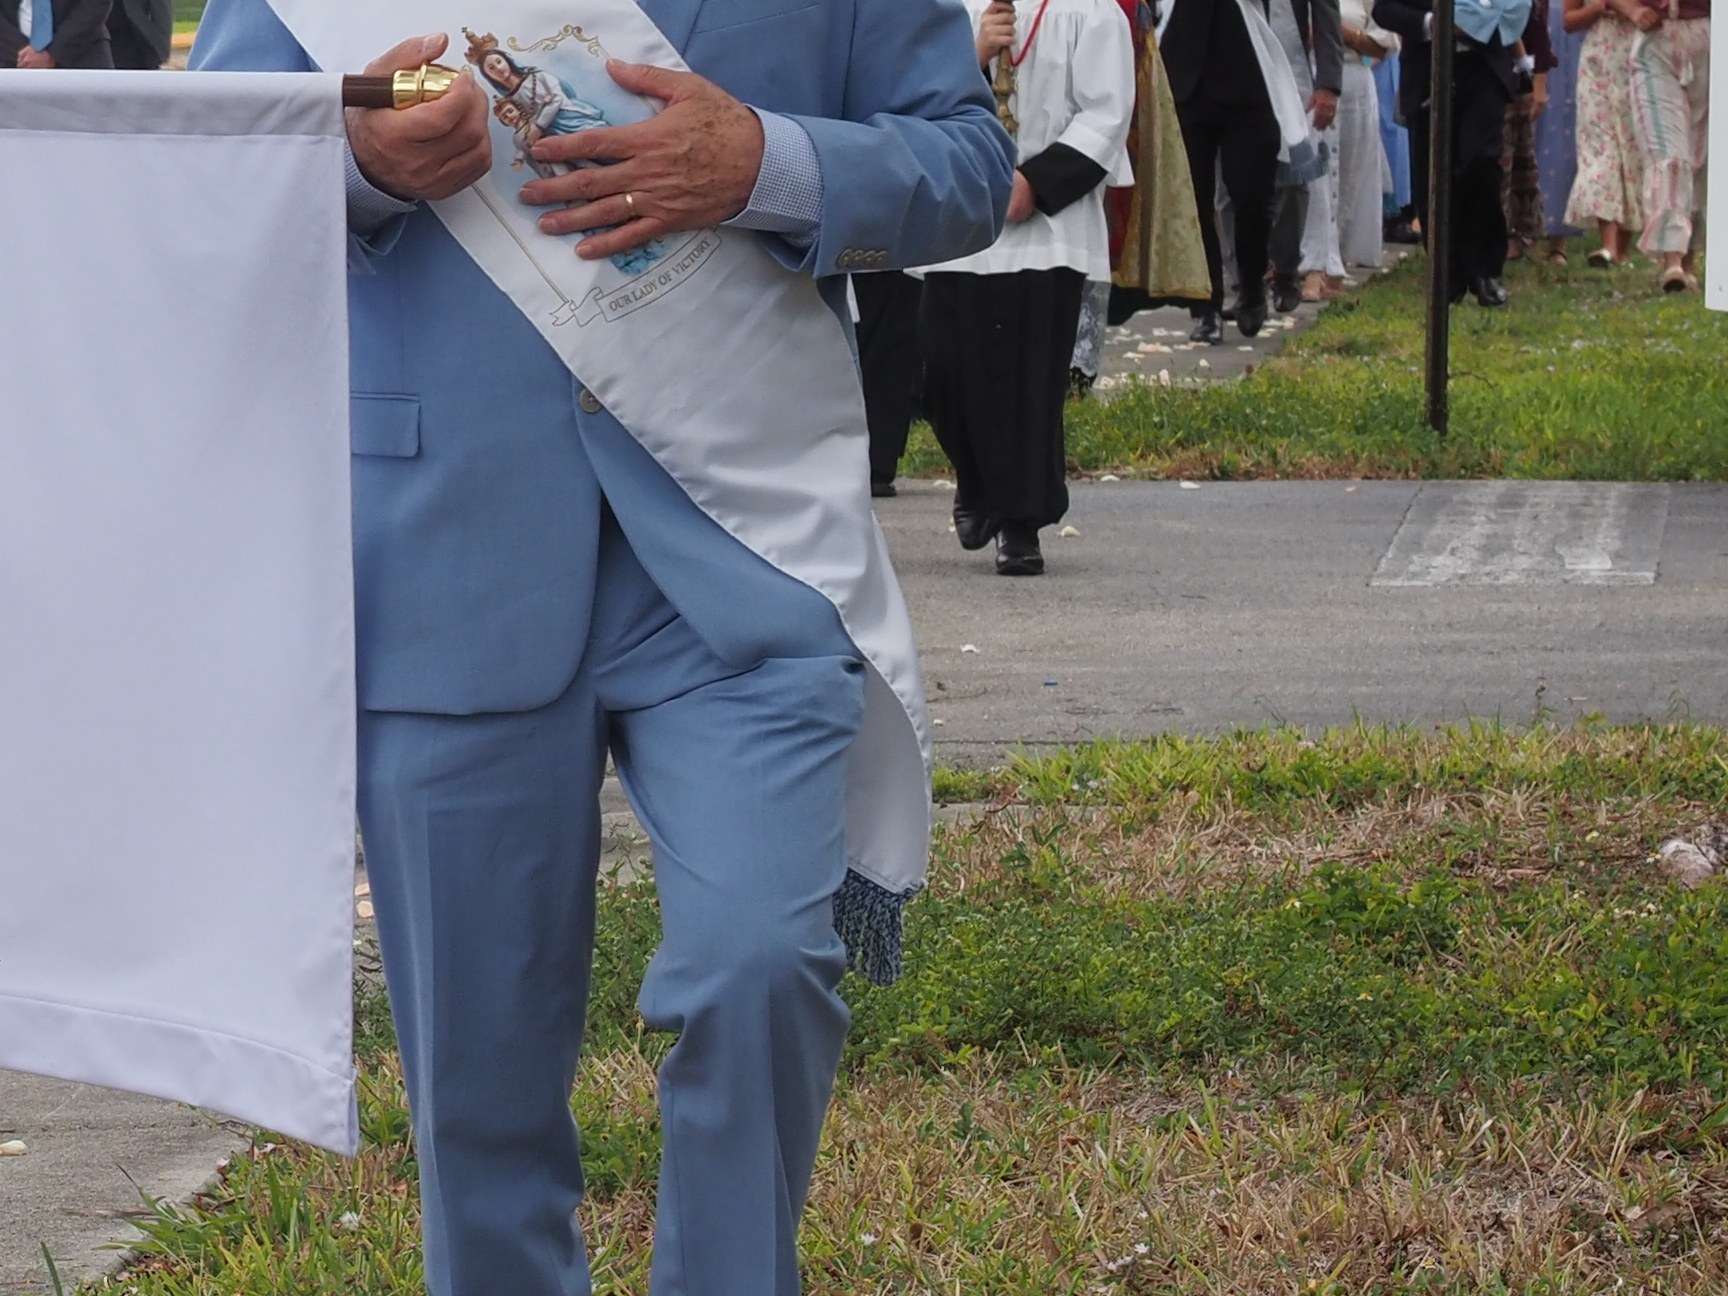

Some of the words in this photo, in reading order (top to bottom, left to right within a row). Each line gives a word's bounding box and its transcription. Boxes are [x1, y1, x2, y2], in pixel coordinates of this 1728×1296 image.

[609, 293, 632, 311] OUR
[633, 278, 658, 302] LADY
[658, 269, 673, 286] OF
[672, 236, 711, 275] VICTORY
